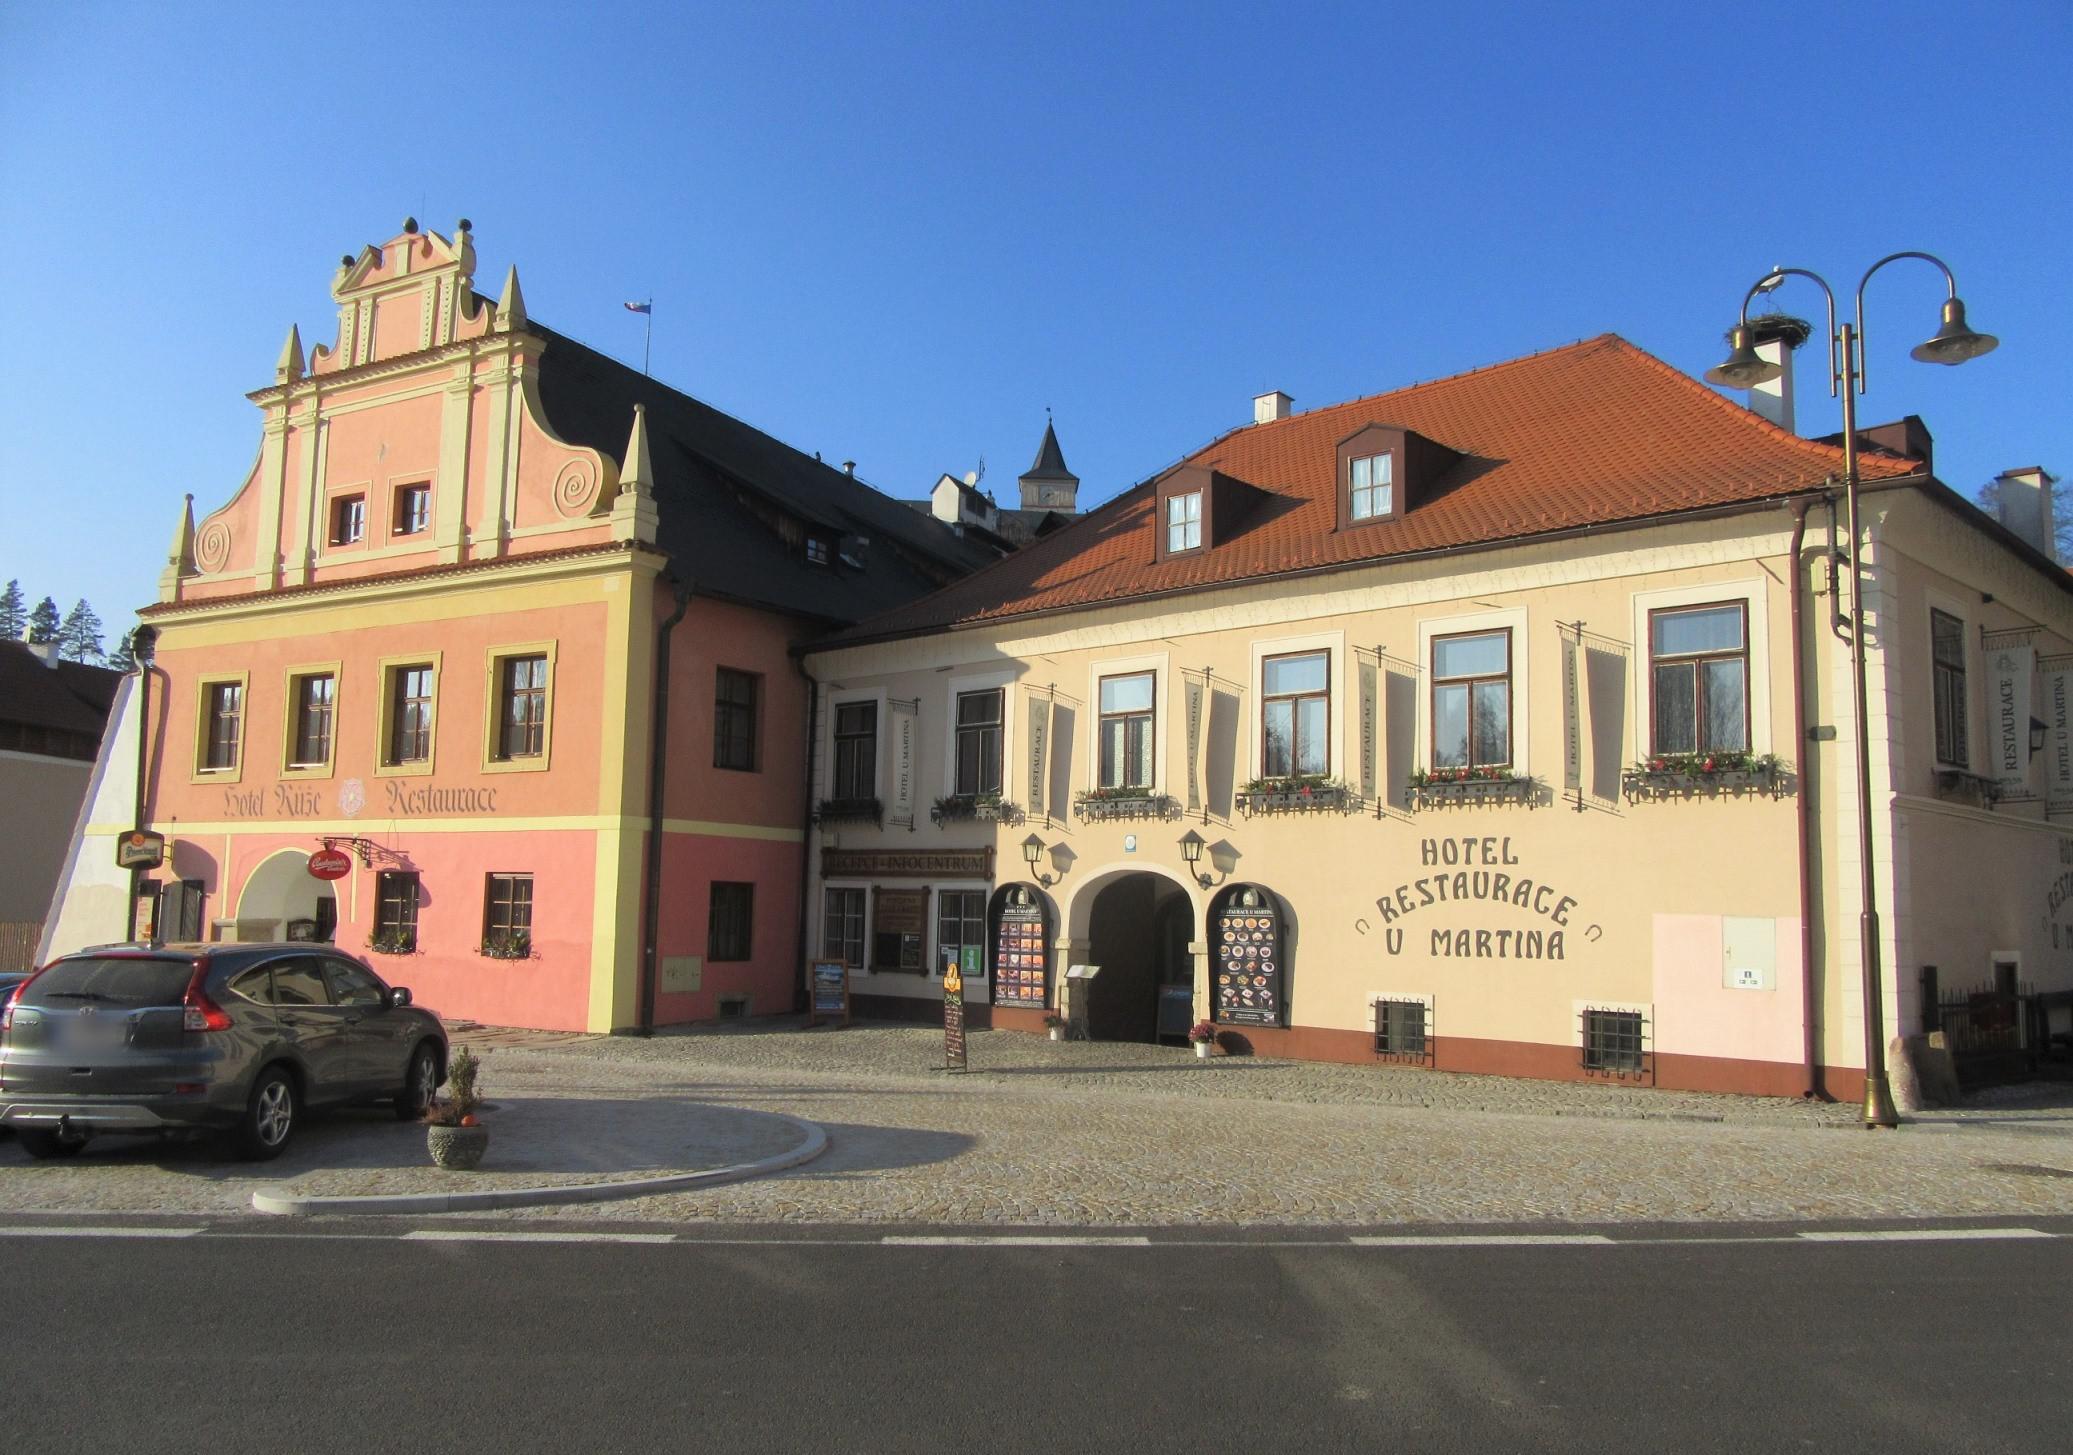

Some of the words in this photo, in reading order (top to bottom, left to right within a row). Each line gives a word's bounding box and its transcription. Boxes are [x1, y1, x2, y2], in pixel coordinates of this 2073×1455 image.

[2054, 675, 2066, 728] MARTINA
[2000, 677, 2017, 770] RESTAURACE
[2057, 731, 2067, 740] U
[1032, 725, 1042, 796] RESTAURACE
[2058, 743, 2070, 781] HOTEL
[385, 780, 498, 815] Restaurace
[900, 773, 908, 801] HOTEL
[887, 855, 983, 871] INFOCENTRUM
[1421, 836, 1519, 866] HOTEL
[1376, 871, 1578, 927] RESTAURACE
[1386, 928, 1403, 955] U
[1430, 929, 1565, 960] MARTINA
